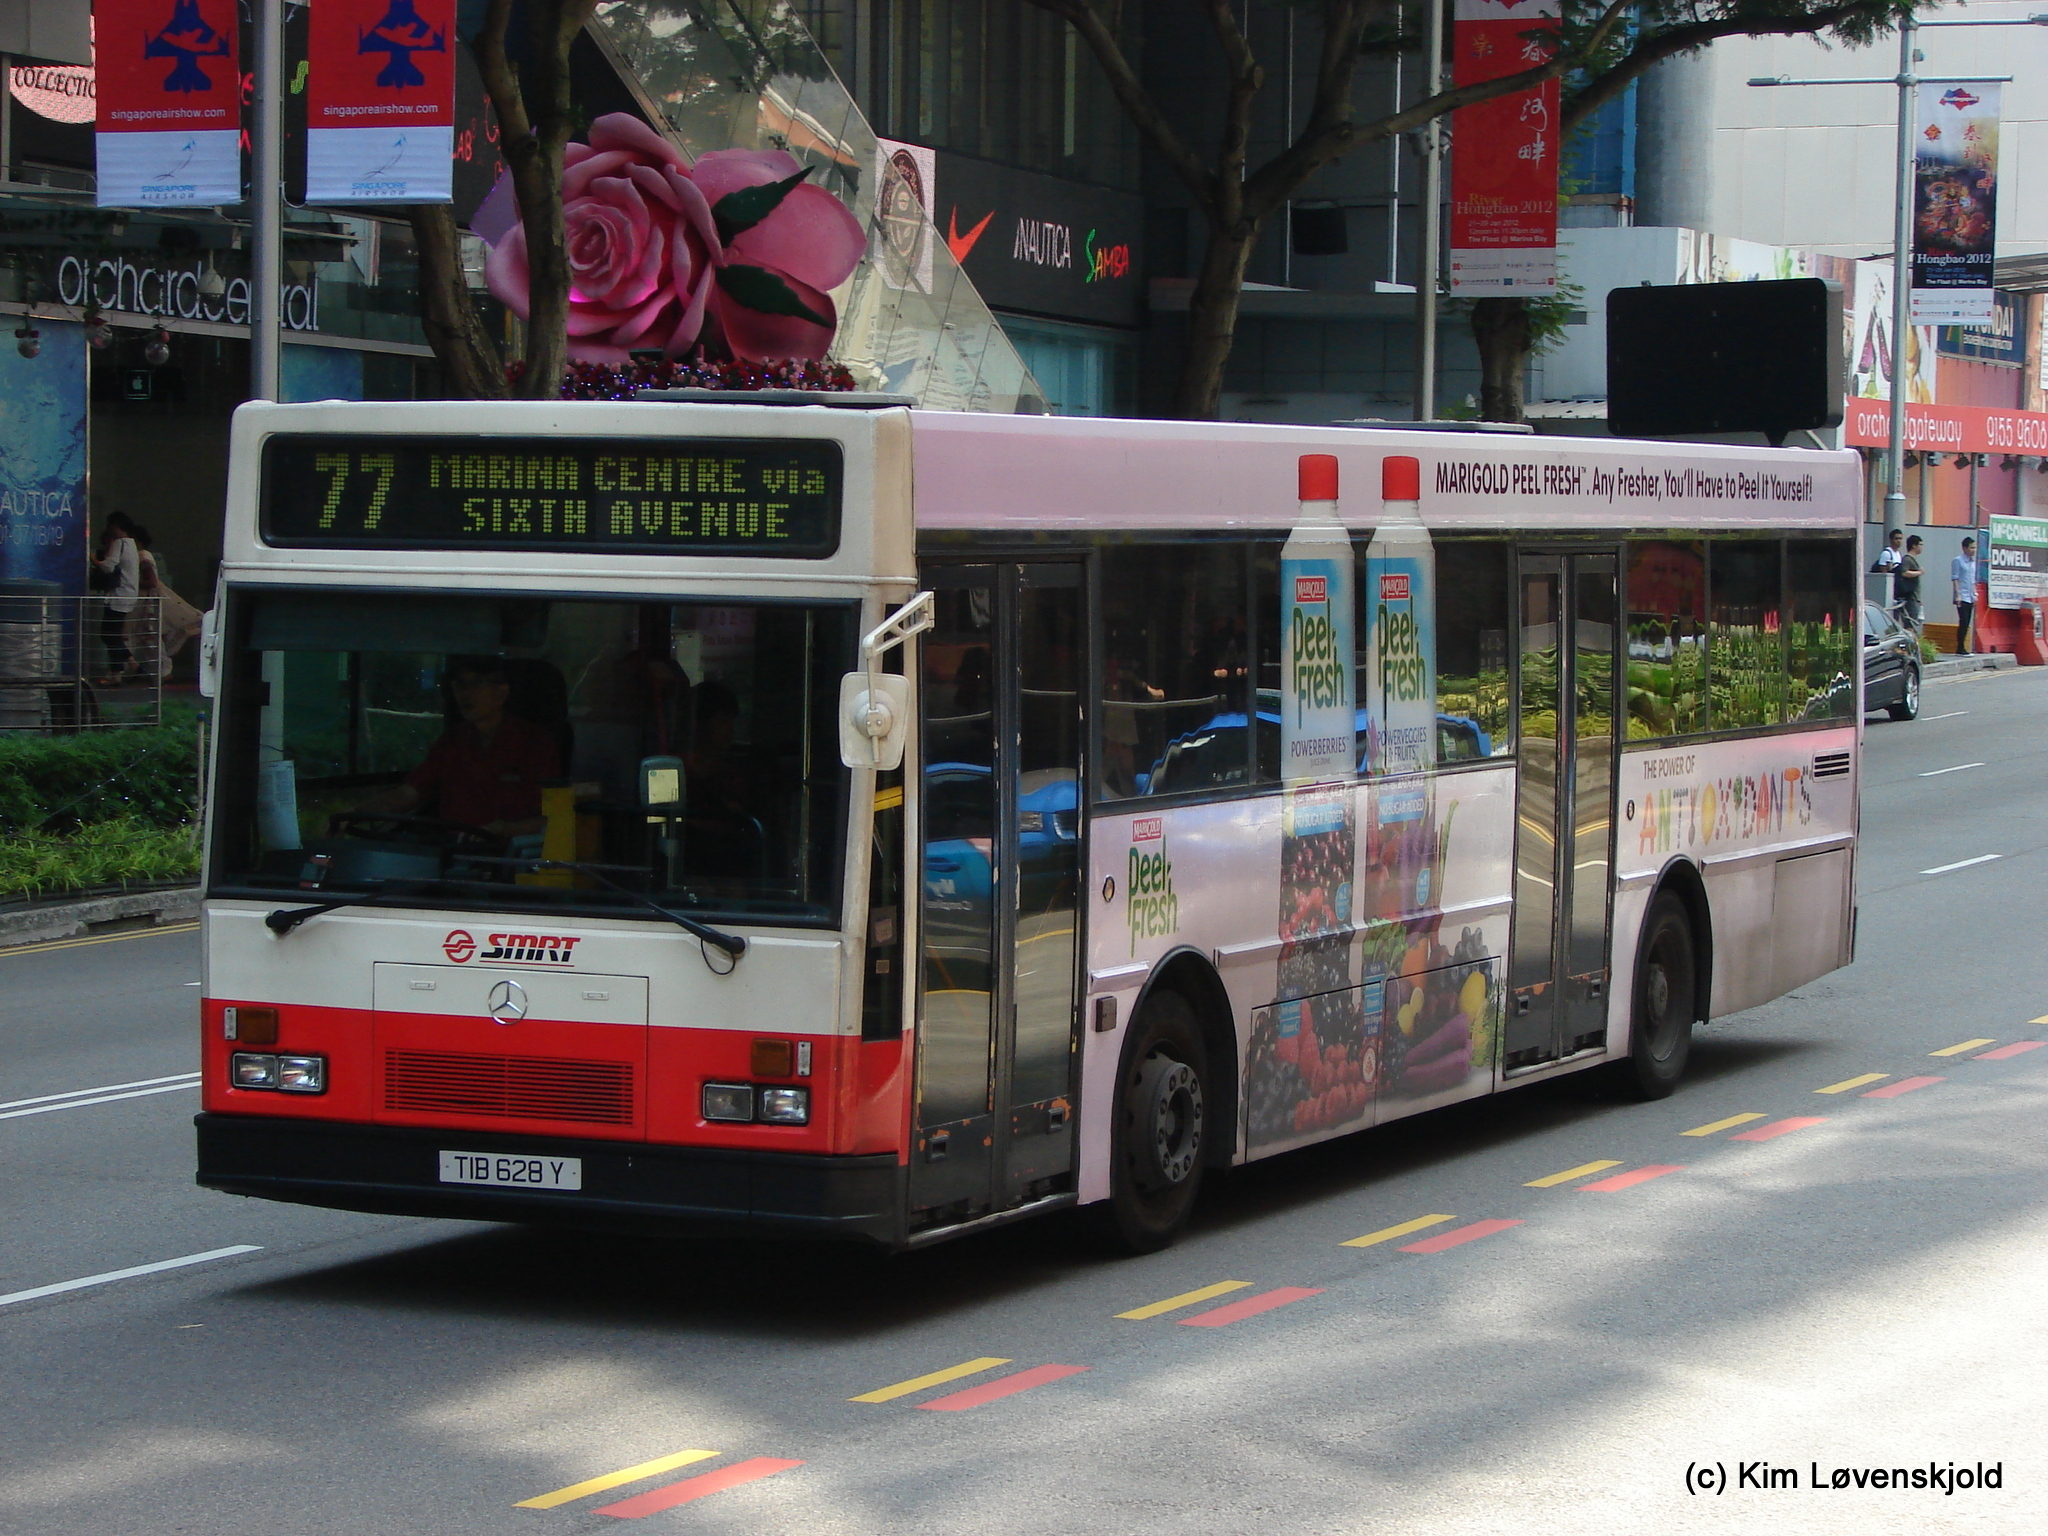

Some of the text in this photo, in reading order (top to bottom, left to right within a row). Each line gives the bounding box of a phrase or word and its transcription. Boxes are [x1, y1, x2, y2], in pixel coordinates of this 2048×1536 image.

[111, 108, 226, 121] singaporeairshow.com
[323, 104, 439, 117] singaporeairshow.com
[1457, 200, 1553, 218] Hongbao 2012
[1013, 217, 1072, 269] NAUTICA
[1916, 253, 1992, 266] Hongbao 2012
[1986, 416, 2013, 447] 9155
[2017, 418, 2047, 449] 9608
[430, 454, 825, 495] MARINA CENTRE via
[1436, 462, 1509, 495] MARIGOLD
[1513, 464, 1541, 495] PEEL
[1592, 471, 1614, 504] Any
[1618, 466, 1662, 502] Fresher,
[1696, 470, 1723, 500] Have
[1725, 473, 1736, 500] to
[1738, 470, 1760, 501] Peel
[1761, 472, 1769, 501] It
[1770, 473, 1813, 503] Yourself!
[316, 453, 395, 529] 77
[462, 497, 789, 539] SIXTH AVENUE
[1992, 549, 2032, 567] DOWELL
[1297, 581, 1325, 598] MARIGOLD
[1381, 578, 1408, 596] MARIGOLD
[1293, 598, 1331, 694] Peel
[1378, 595, 1414, 688] Peel
[1298, 640, 1345, 730] Fresh
[1383, 637, 1426, 720] Fresh
[1377, 726, 1427, 747] POWERVEGGIES
[1643, 754, 1696, 780] THE POWER OF
[1133, 819, 1161, 839] MARIGOLD
[1127, 834, 1167, 927] Peel
[1131, 874, 1178, 959] Fresh
[480, 933, 581, 963] SMRT
[454, 1155, 564, 1185] TIB 628 Y
